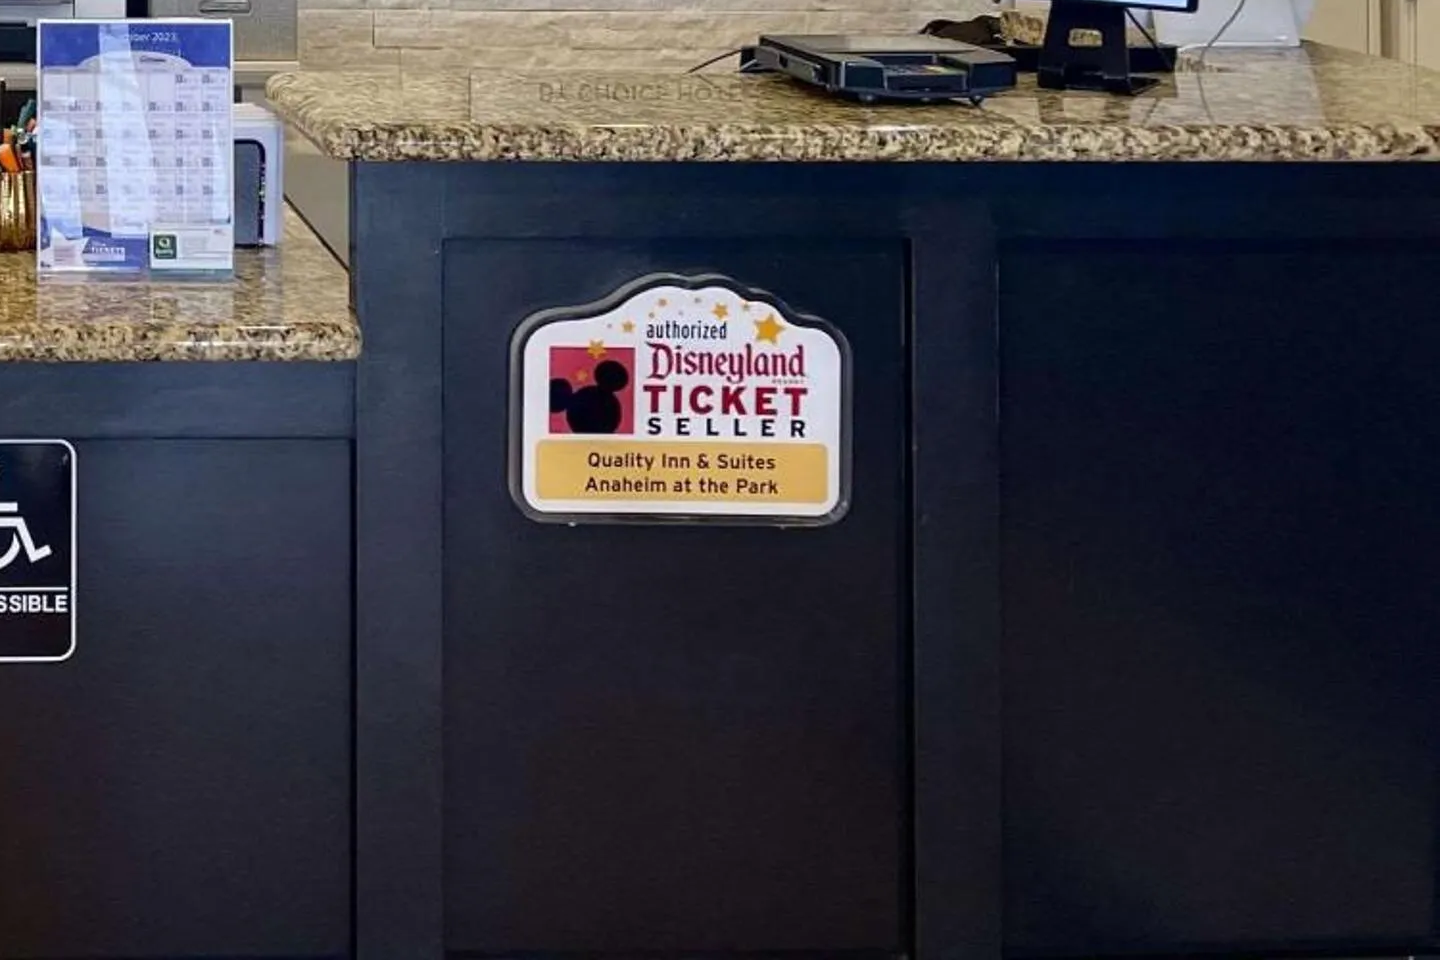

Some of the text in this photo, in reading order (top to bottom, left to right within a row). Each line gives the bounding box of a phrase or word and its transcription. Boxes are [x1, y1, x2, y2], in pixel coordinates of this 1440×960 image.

[646, 320, 728, 340] authorized
[645, 341, 806, 385] Disneyland
[642, 384, 809, 417] TICKET
[647, 417, 806, 438] SELLER
[587, 452, 777, 470] Quality Inn & Suites
[585, 476, 779, 495] Anaheim at the Park
